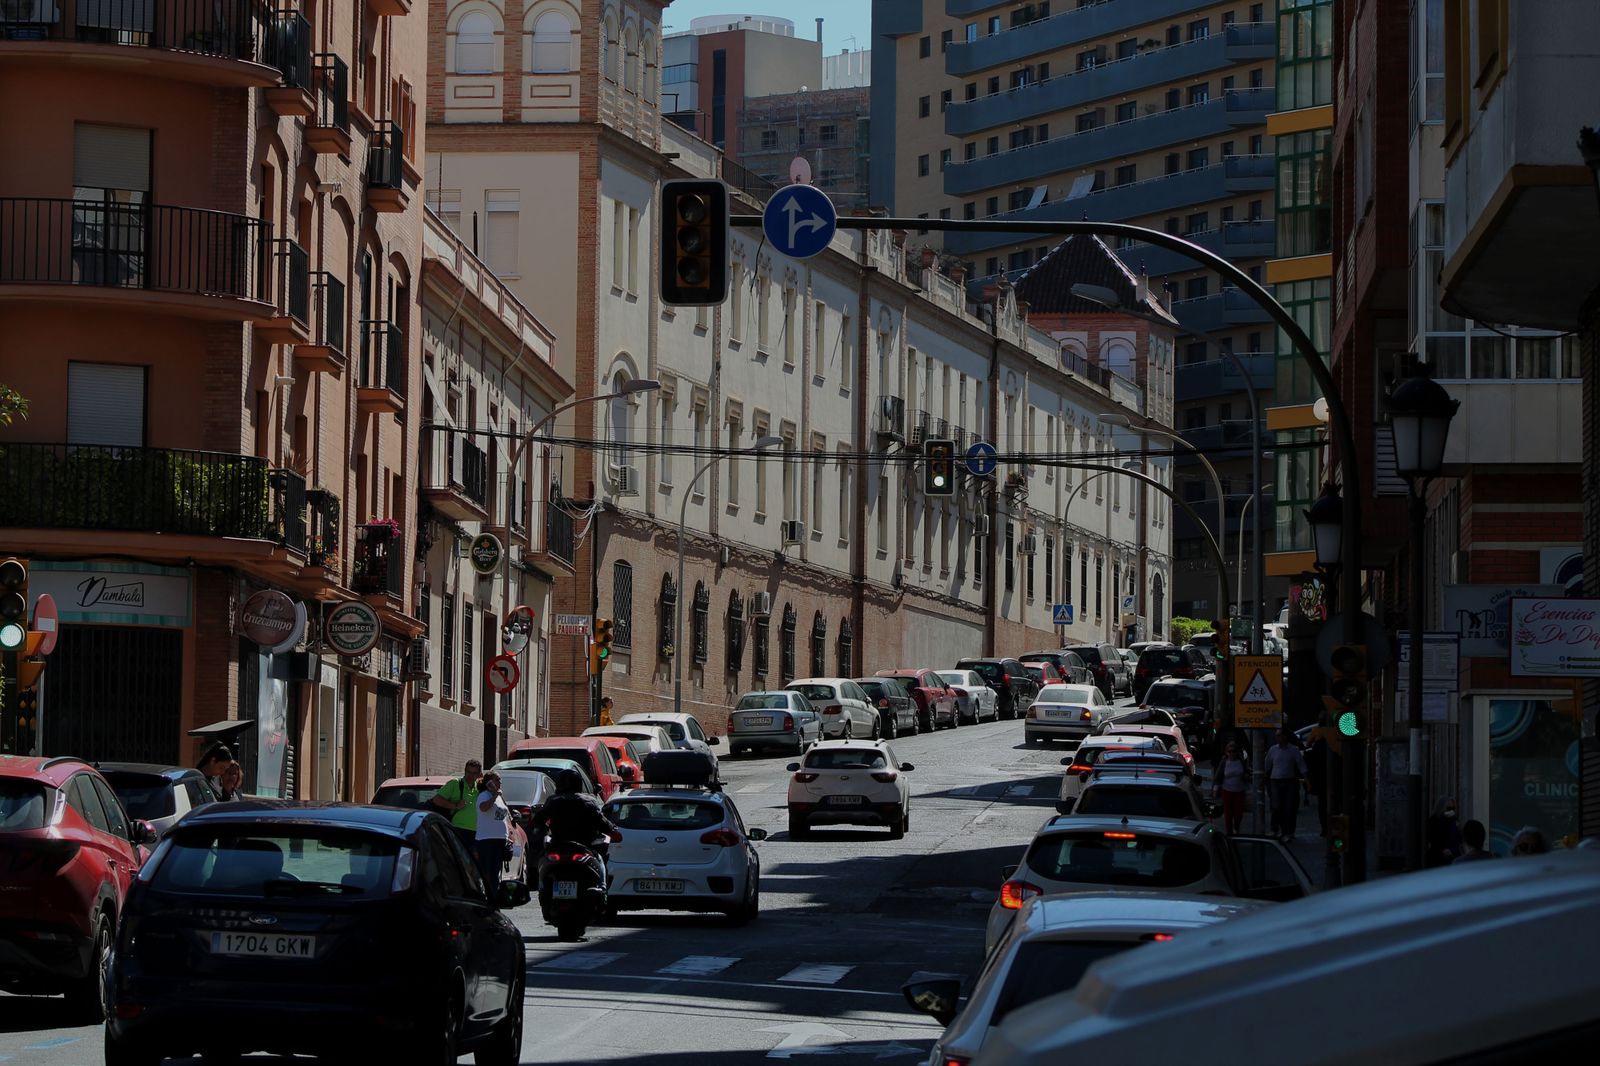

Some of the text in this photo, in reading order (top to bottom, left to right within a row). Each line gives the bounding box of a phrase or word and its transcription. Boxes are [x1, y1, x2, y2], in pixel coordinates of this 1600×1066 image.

[77, 577, 142, 607] Dambala
[243, 612, 293, 631] Cruzcampo
[1524, 601, 1596, 623] Esencias
[332, 623, 372, 632] Heineken
[1535, 624, 1568, 644] De
[226, 934, 310, 955] 1704 GKW
